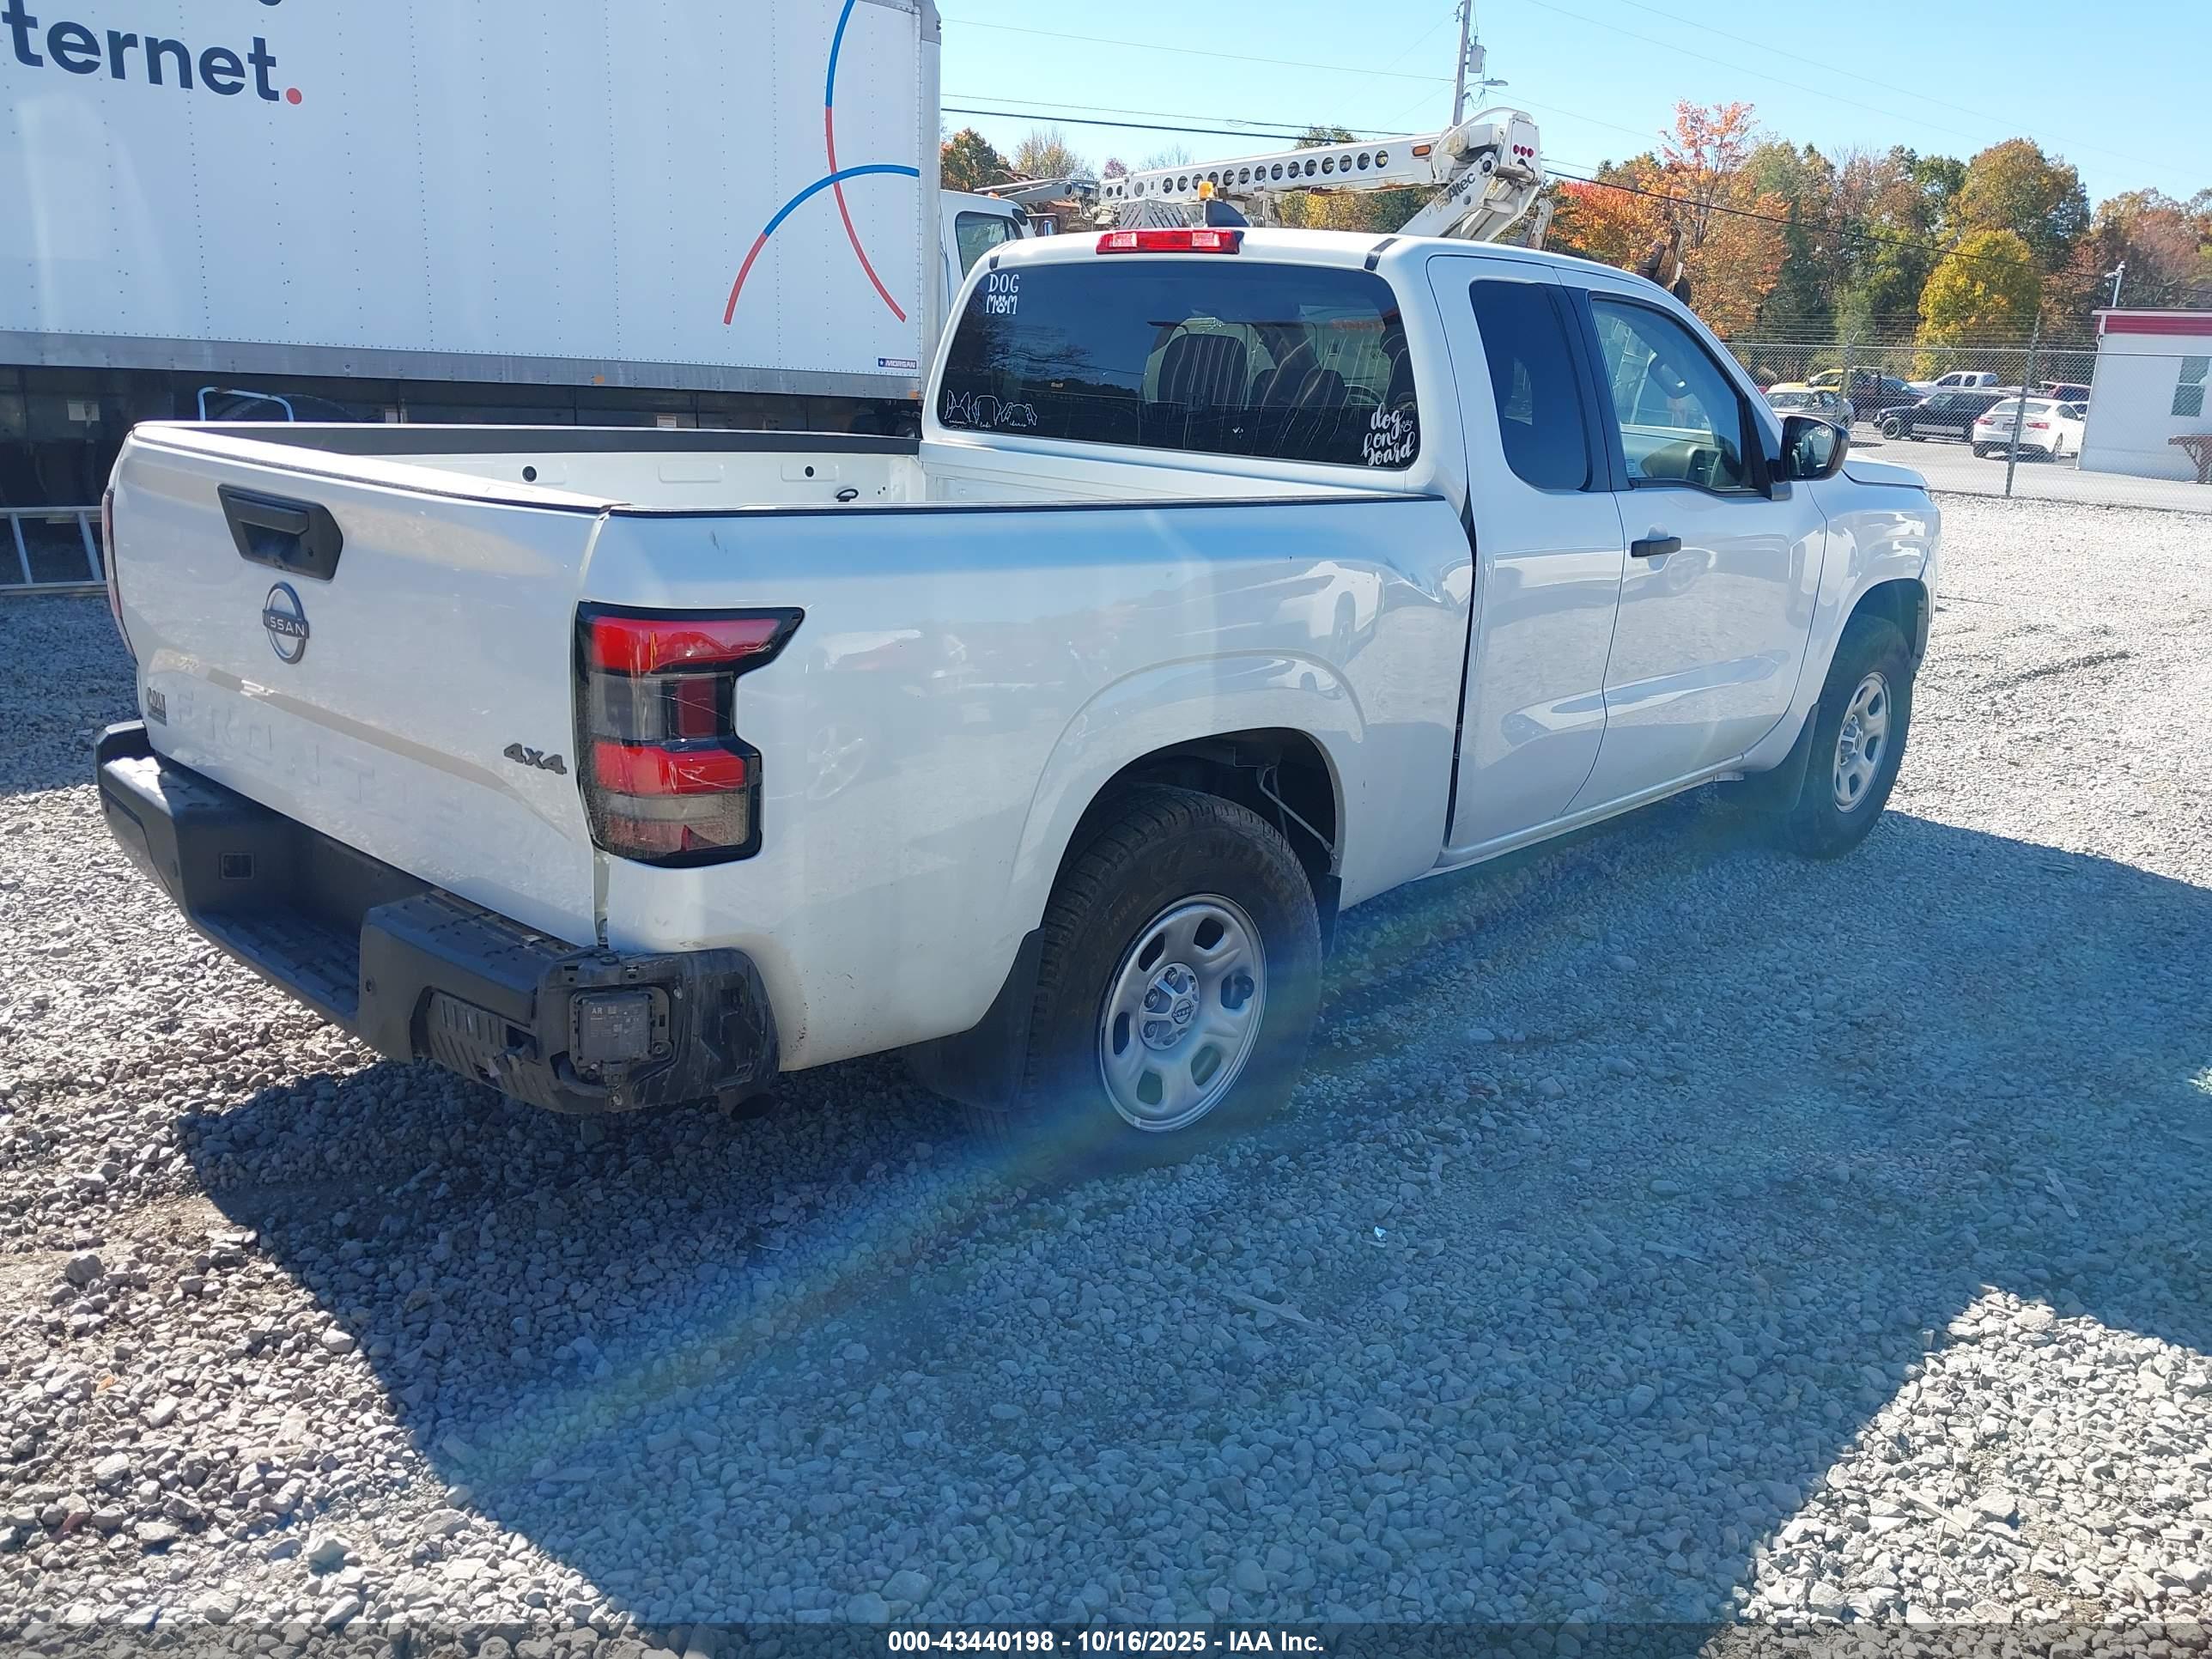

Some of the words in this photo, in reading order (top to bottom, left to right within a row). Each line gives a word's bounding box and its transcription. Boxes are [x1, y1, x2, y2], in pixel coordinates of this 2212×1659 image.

[1448, 173, 1476, 203] Altec
[988, 273, 1019, 293] DOG
[884, 359, 916, 368] MORGAN
[1370, 402, 1405, 440] dog
[1360, 431, 1416, 466] board
[1373, 432, 1396, 448] on
